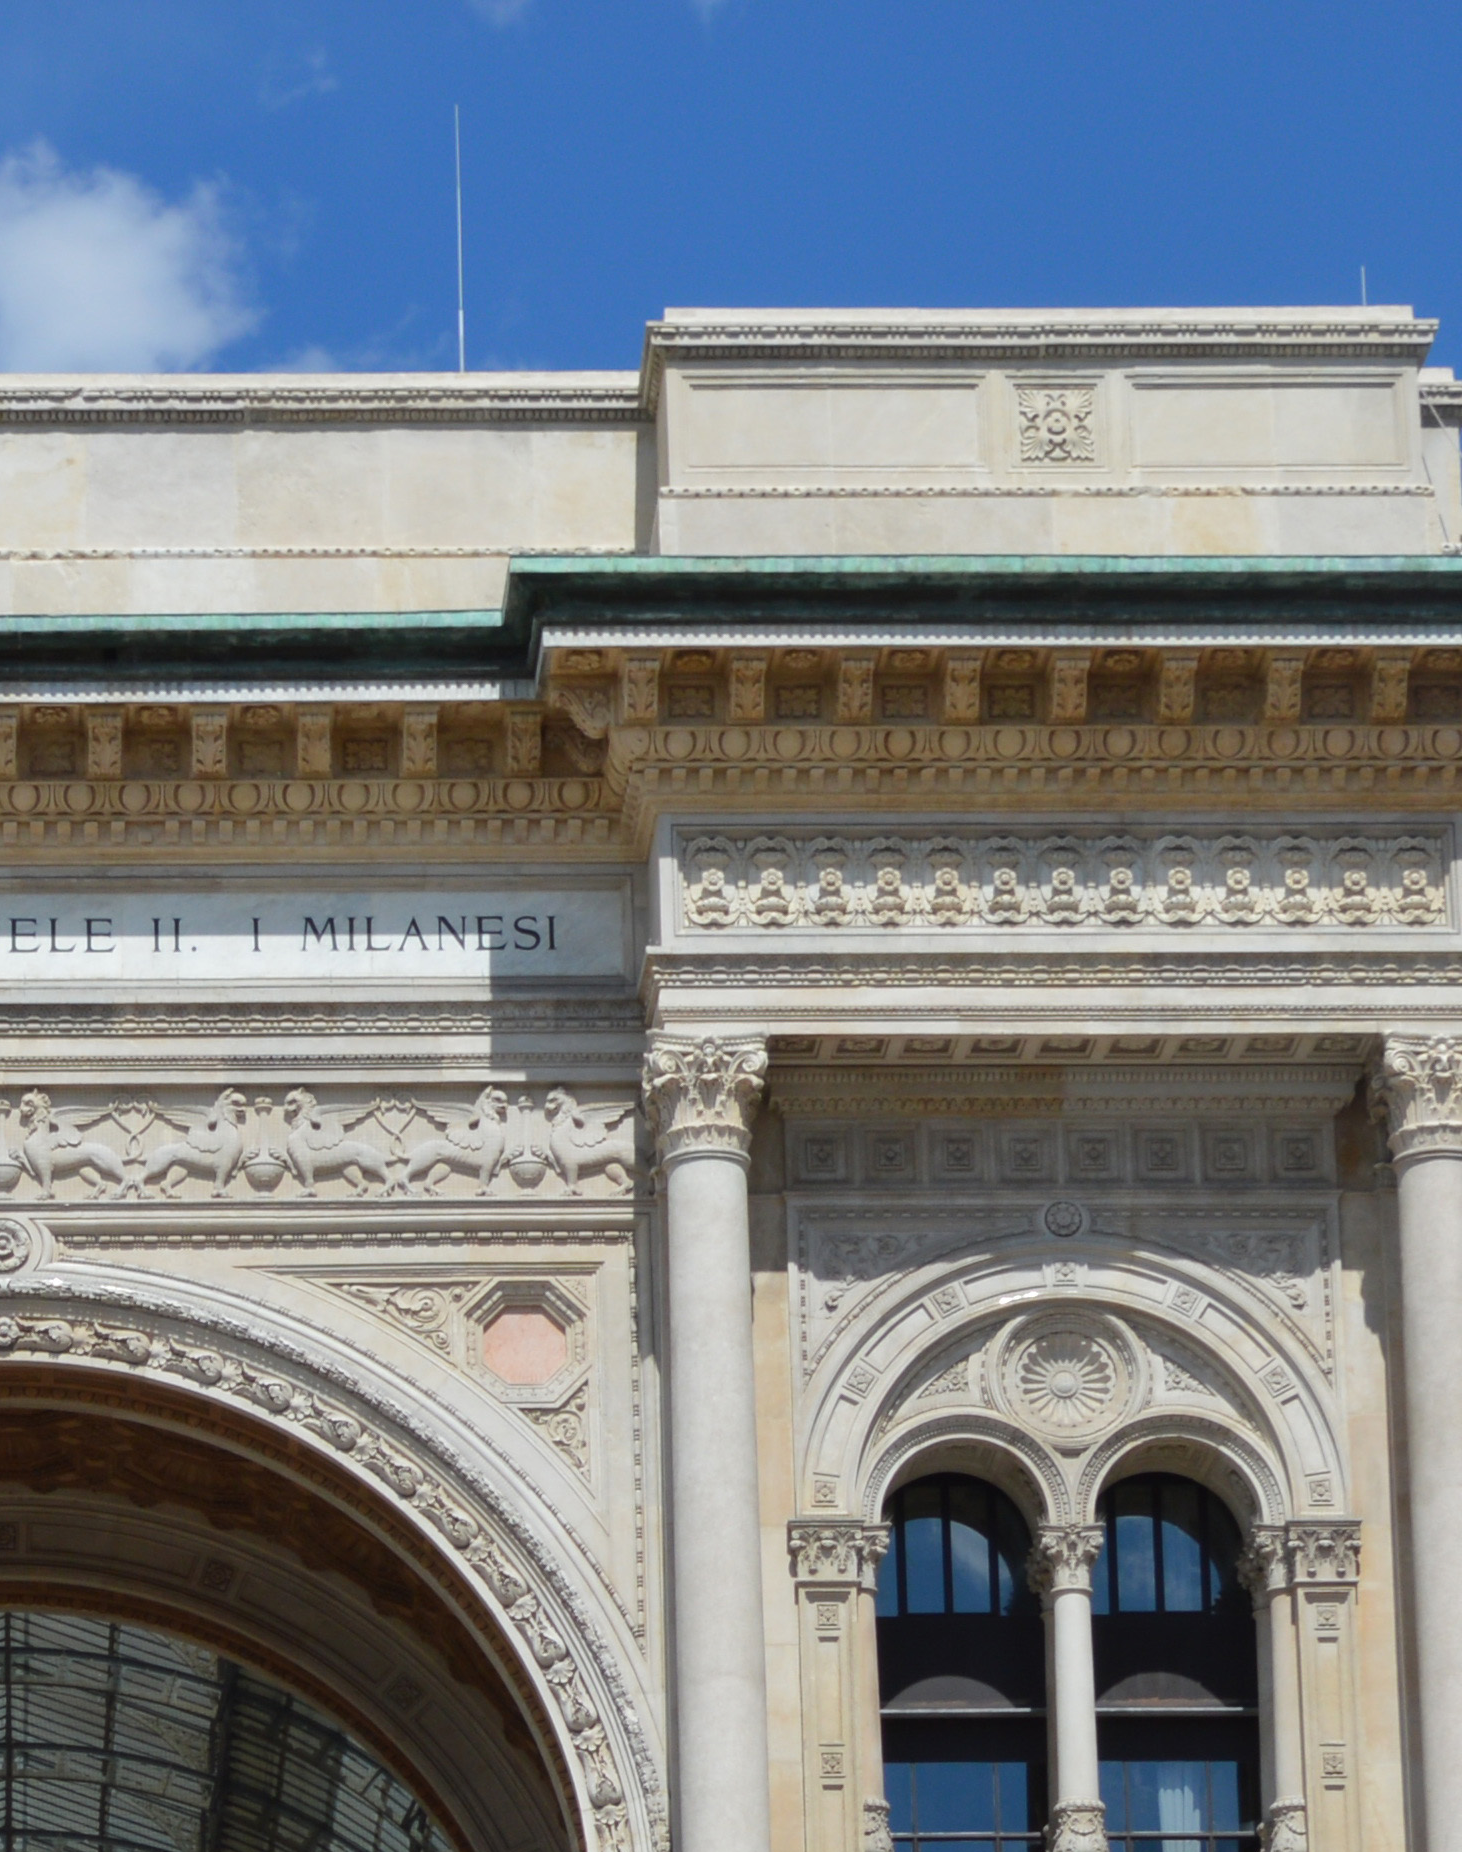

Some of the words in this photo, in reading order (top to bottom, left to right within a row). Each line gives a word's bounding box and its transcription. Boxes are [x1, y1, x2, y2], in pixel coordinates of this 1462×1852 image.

[151, 916, 198, 952] II.
[251, 916, 263, 952] I
[301, 914, 558, 951] MILANESI
